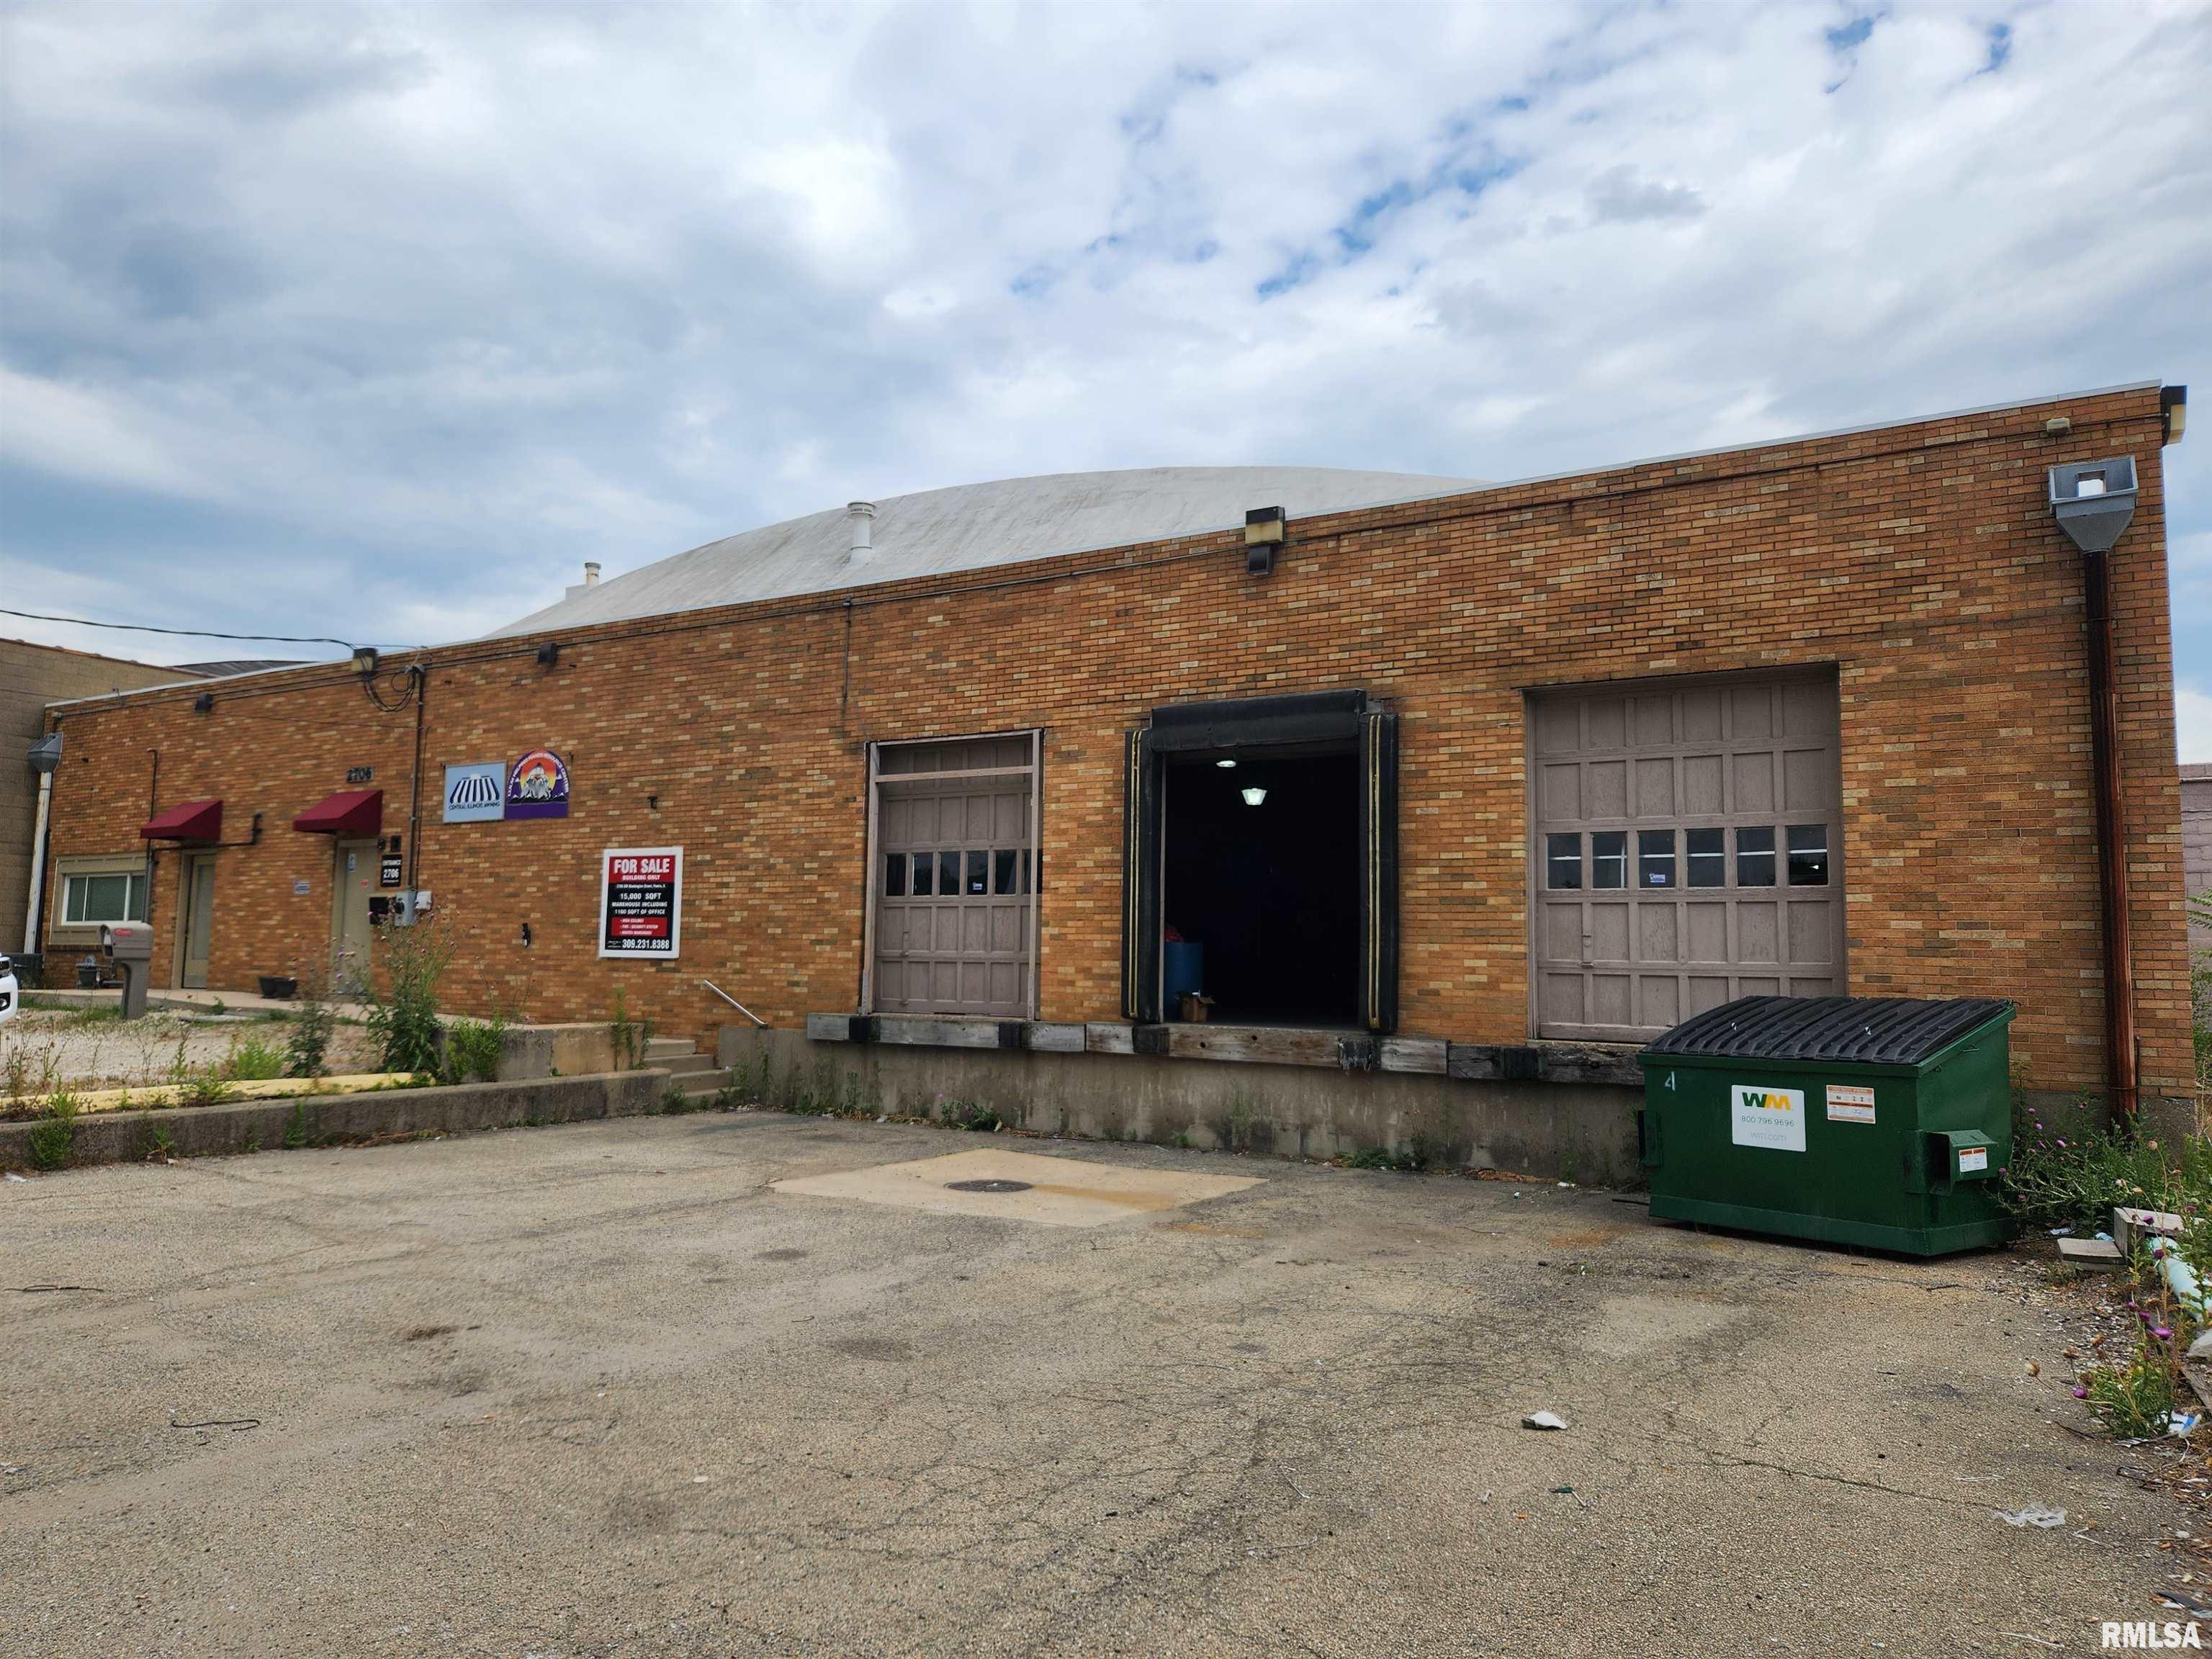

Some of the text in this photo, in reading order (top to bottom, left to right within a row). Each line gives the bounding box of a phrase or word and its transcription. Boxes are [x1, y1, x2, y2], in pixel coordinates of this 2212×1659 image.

[614, 858, 670, 873] FOR SALE
[622, 939, 670, 949] 309.231.8388
[1665, 1071, 1676, 1092] 4
[1741, 1092, 1791, 1110] WM
[1750, 1132, 1786, 1141] wm.com
